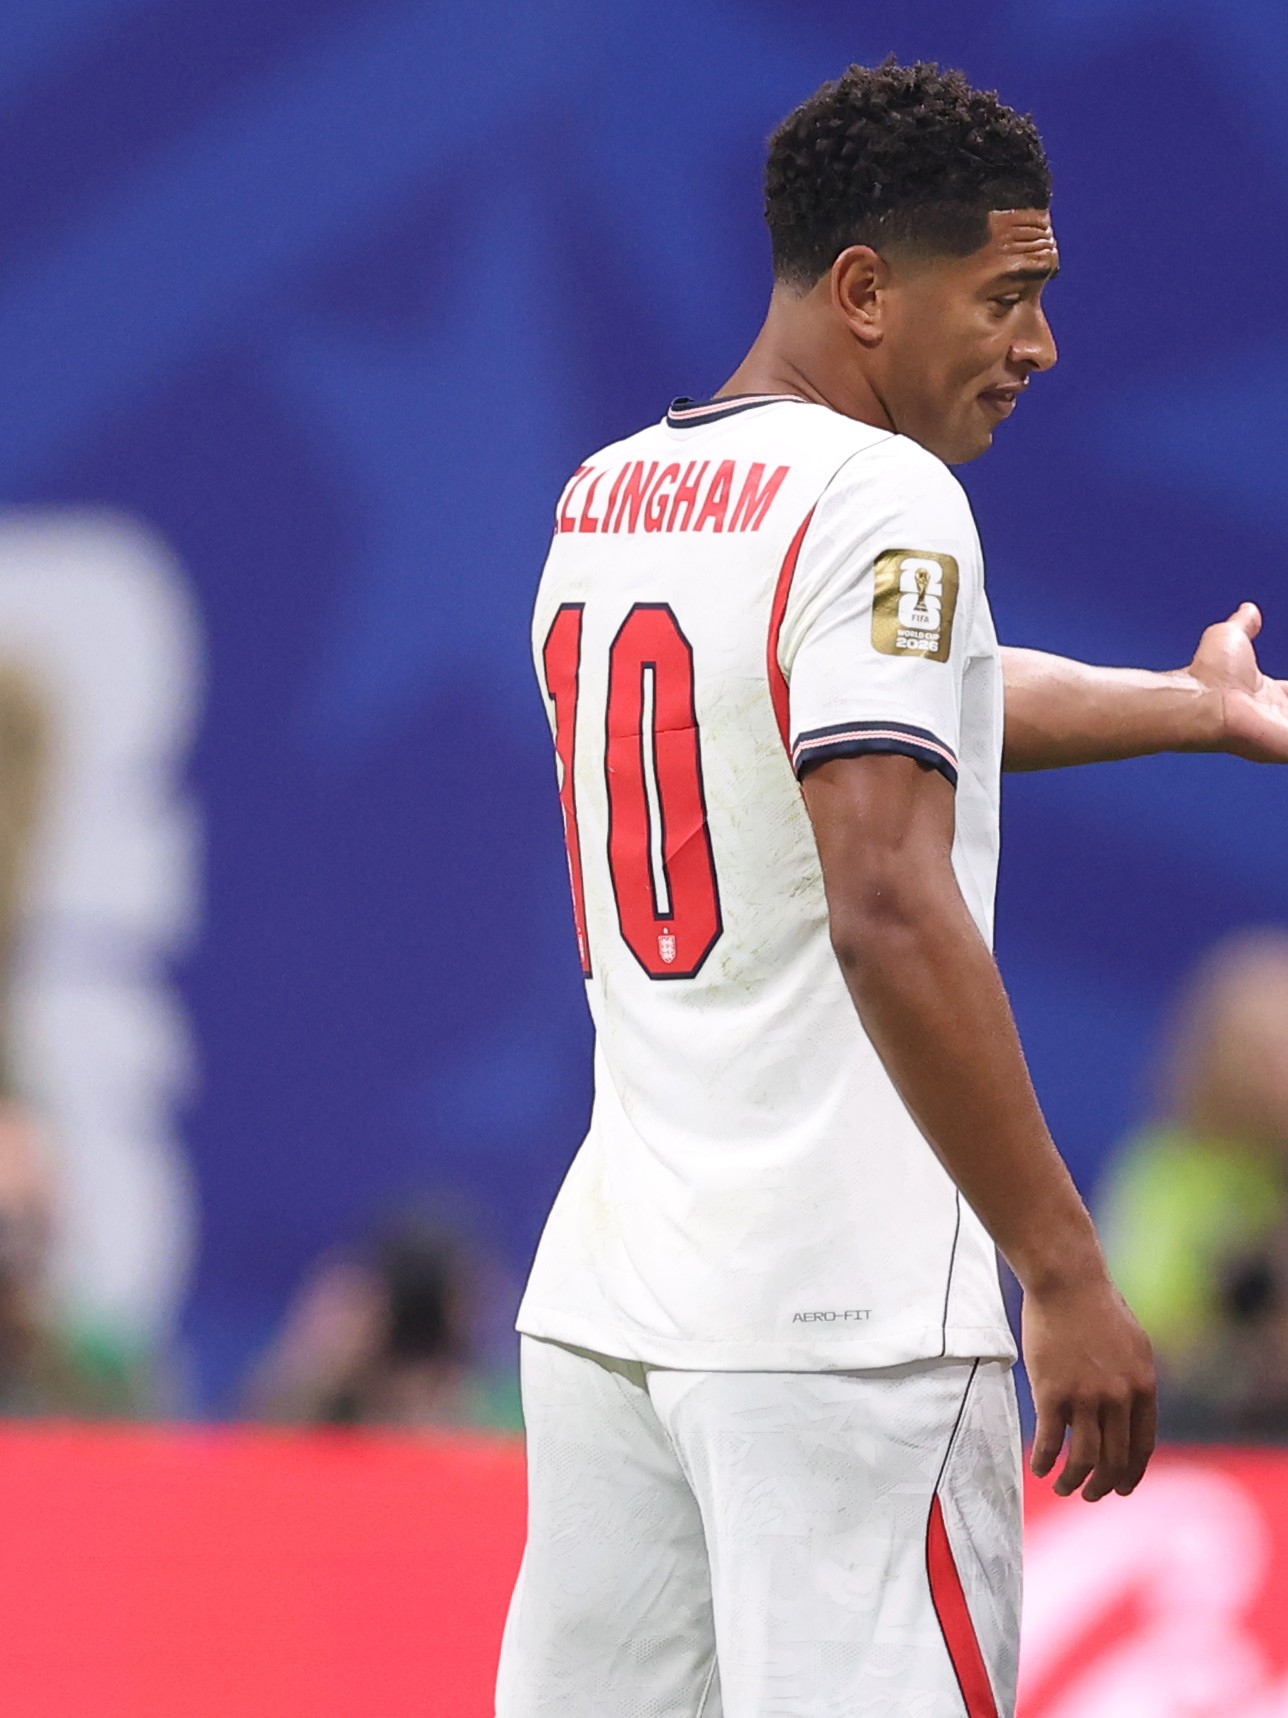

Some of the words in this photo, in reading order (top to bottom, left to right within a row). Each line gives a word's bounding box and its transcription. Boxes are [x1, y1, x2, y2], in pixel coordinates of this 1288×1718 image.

[554, 459, 791, 535] LLINGHAM
[911, 613, 930, 623] FIFA
[897, 630, 924, 638] WORLD
[896, 637, 938, 651] 2026
[543, 602, 723, 980] 10
[792, 1309, 872, 1324] AERO-FIT
